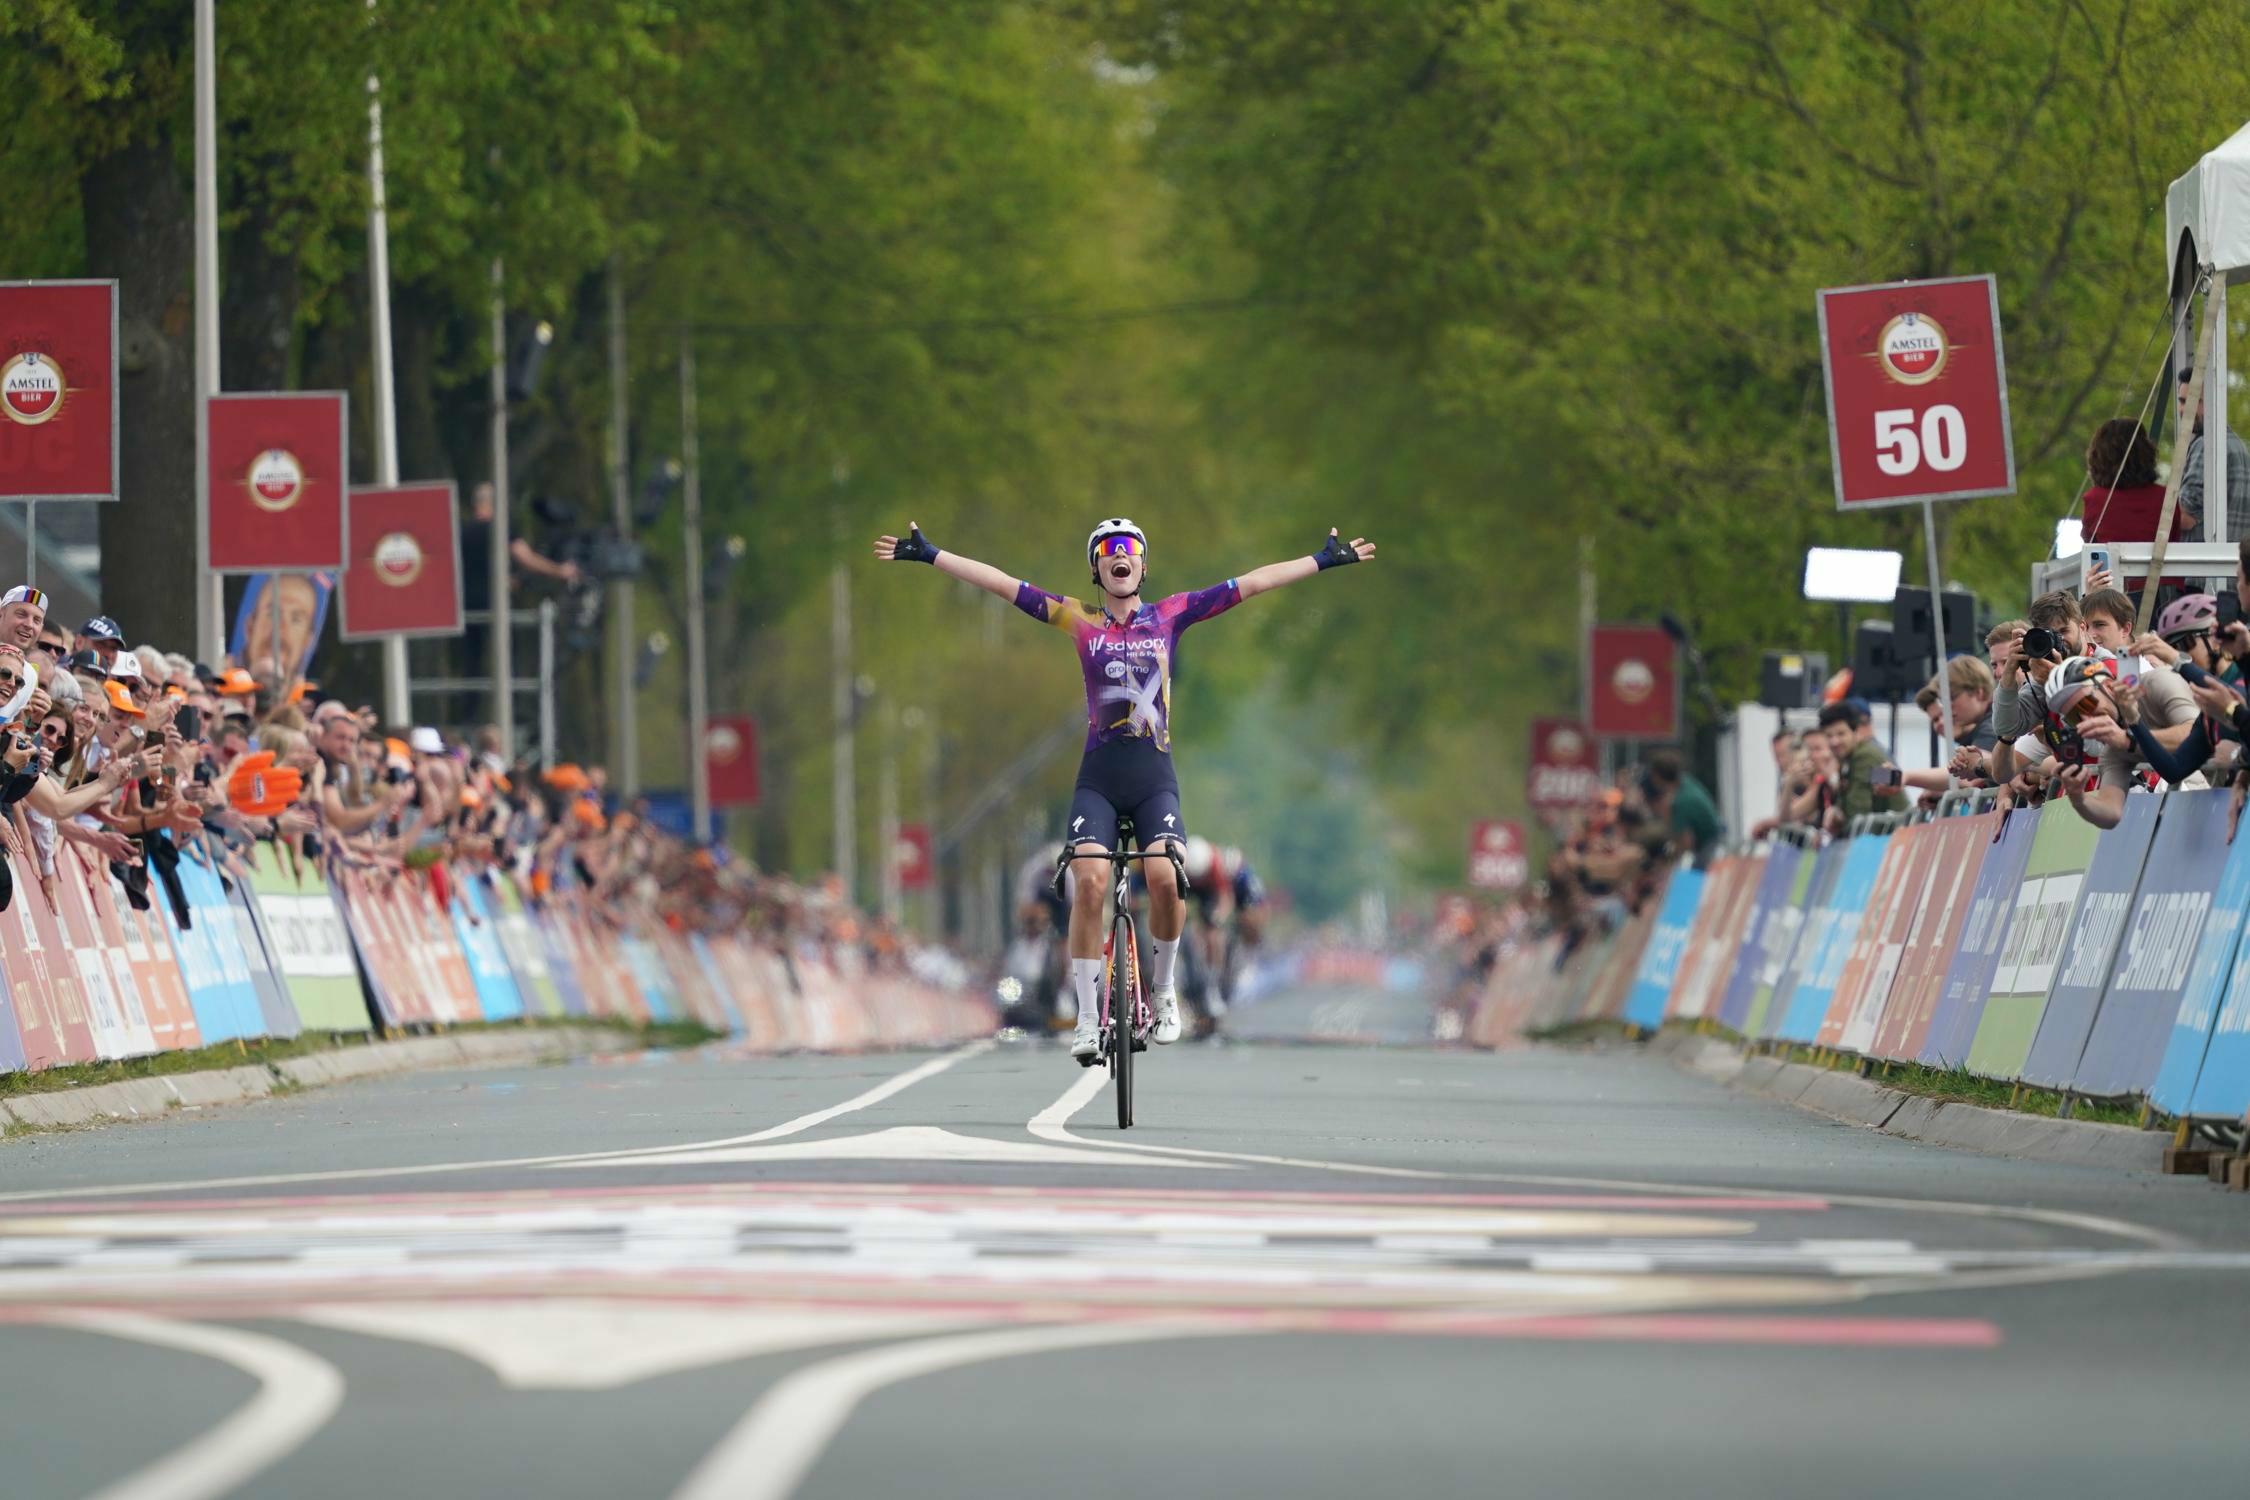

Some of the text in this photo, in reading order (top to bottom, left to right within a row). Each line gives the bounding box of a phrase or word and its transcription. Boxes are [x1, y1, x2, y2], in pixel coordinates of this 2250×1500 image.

[1892, 337, 1935, 350] AMSTEL
[1903, 352, 1925, 362] BIER
[9, 378, 54, 389] AMSTEL
[21, 391, 42, 402] BIER
[1874, 404, 1967, 476] 50
[2115, 891, 2211, 991] SHIMANO
